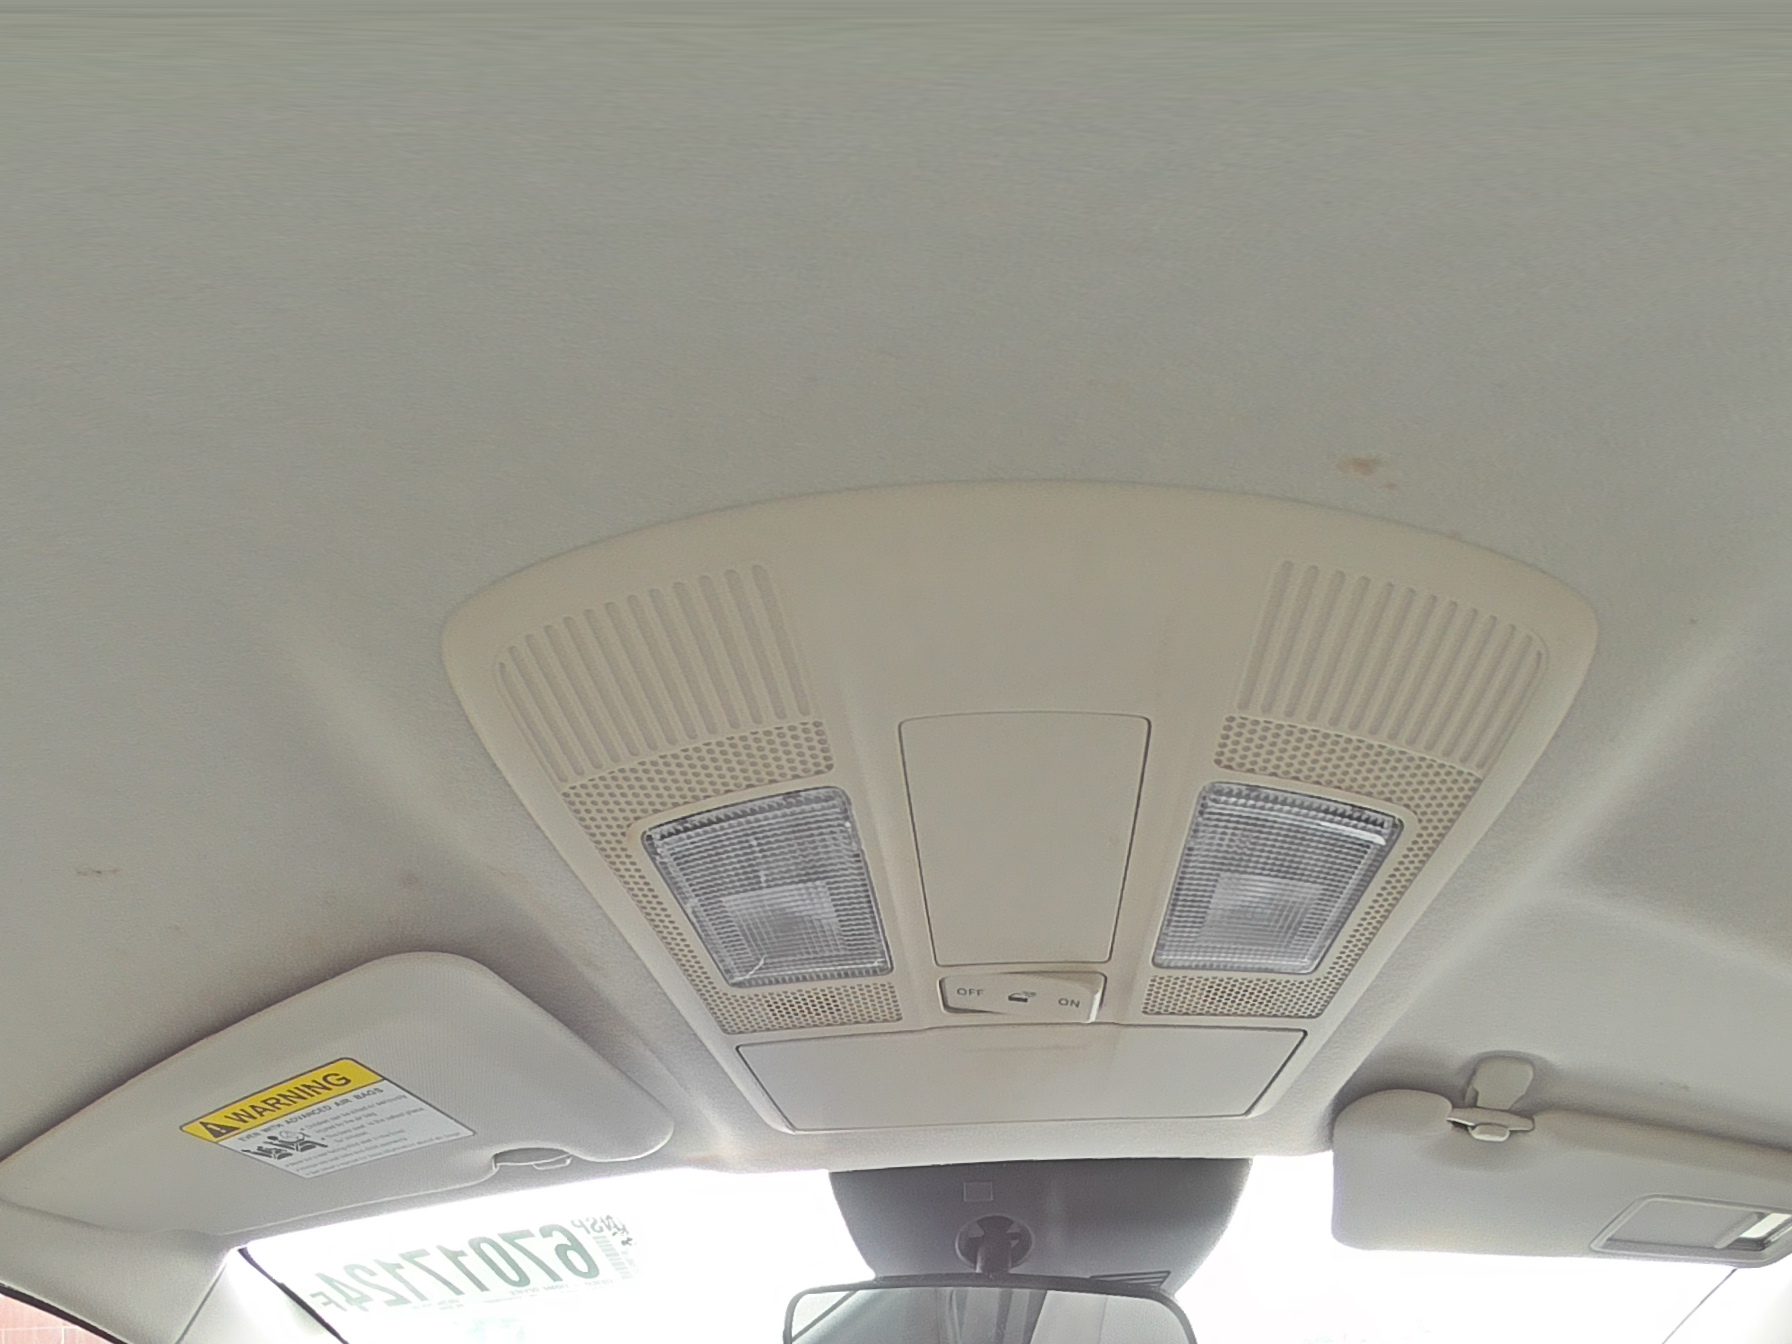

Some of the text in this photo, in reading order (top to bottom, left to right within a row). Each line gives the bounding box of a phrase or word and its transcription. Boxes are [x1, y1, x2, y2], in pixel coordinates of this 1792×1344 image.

[956, 987, 1081, 1009] OFF ON
[225, 1072, 353, 1124] WARNING
[286, 1105, 333, 1124] ADVANCED
[334, 1098, 352, 1107] AIR
[354, 1087, 384, 1100] BAGS
